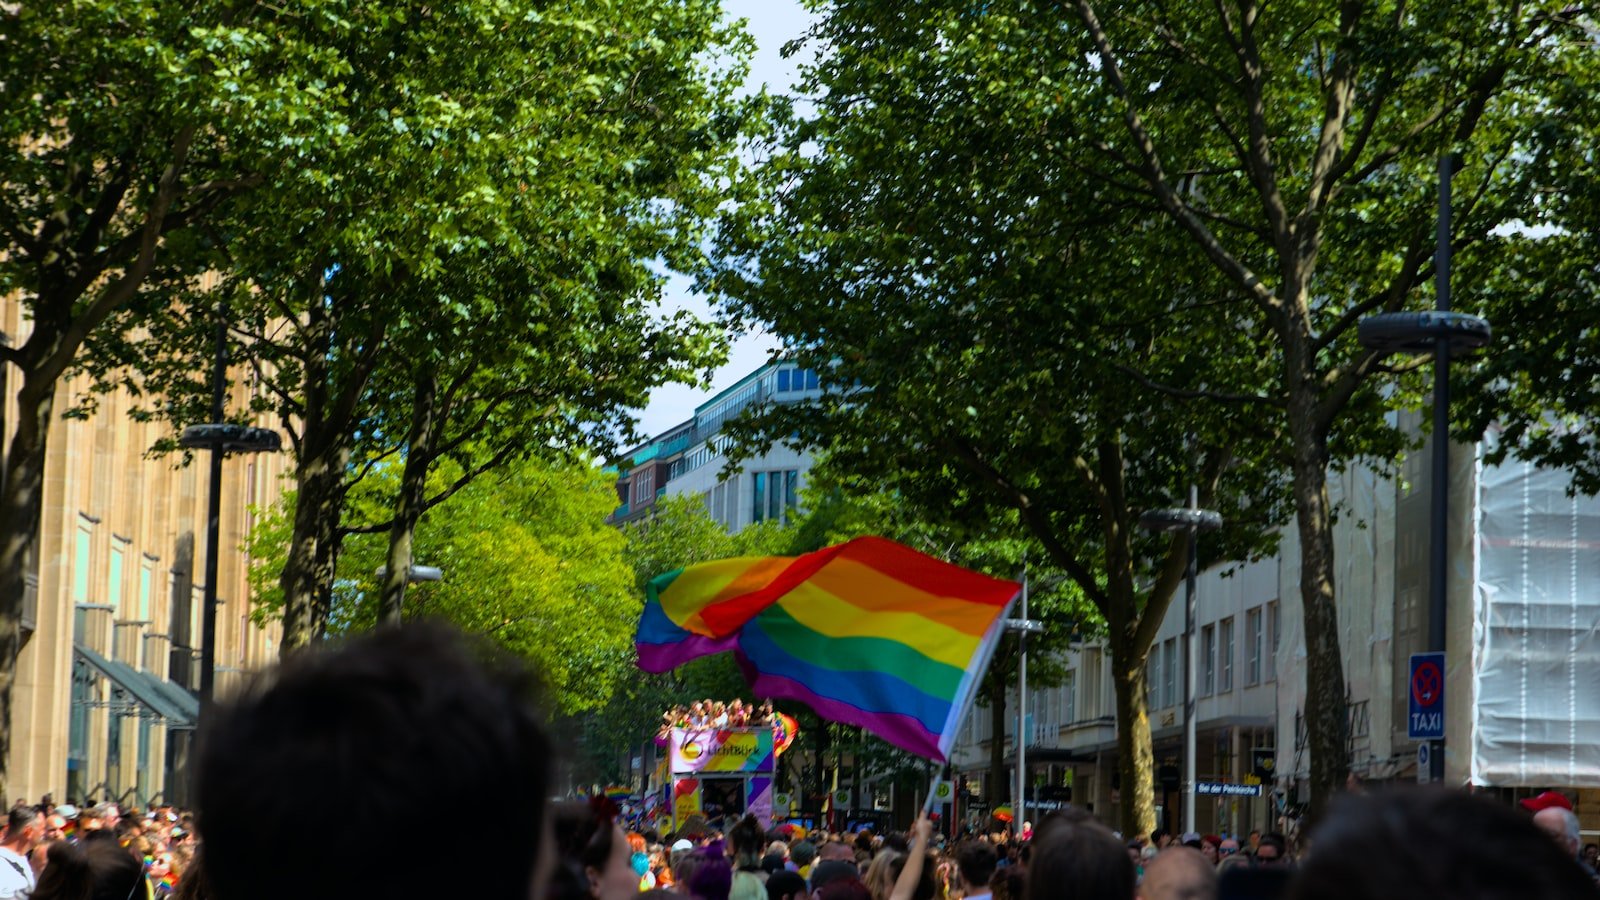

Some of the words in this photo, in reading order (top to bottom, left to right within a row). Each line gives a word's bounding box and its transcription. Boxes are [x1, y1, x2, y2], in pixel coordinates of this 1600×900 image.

[1411, 712, 1441, 731] TAXI
[1199, 783, 1210, 793] Bei
[1210, 784, 1221, 794] der
